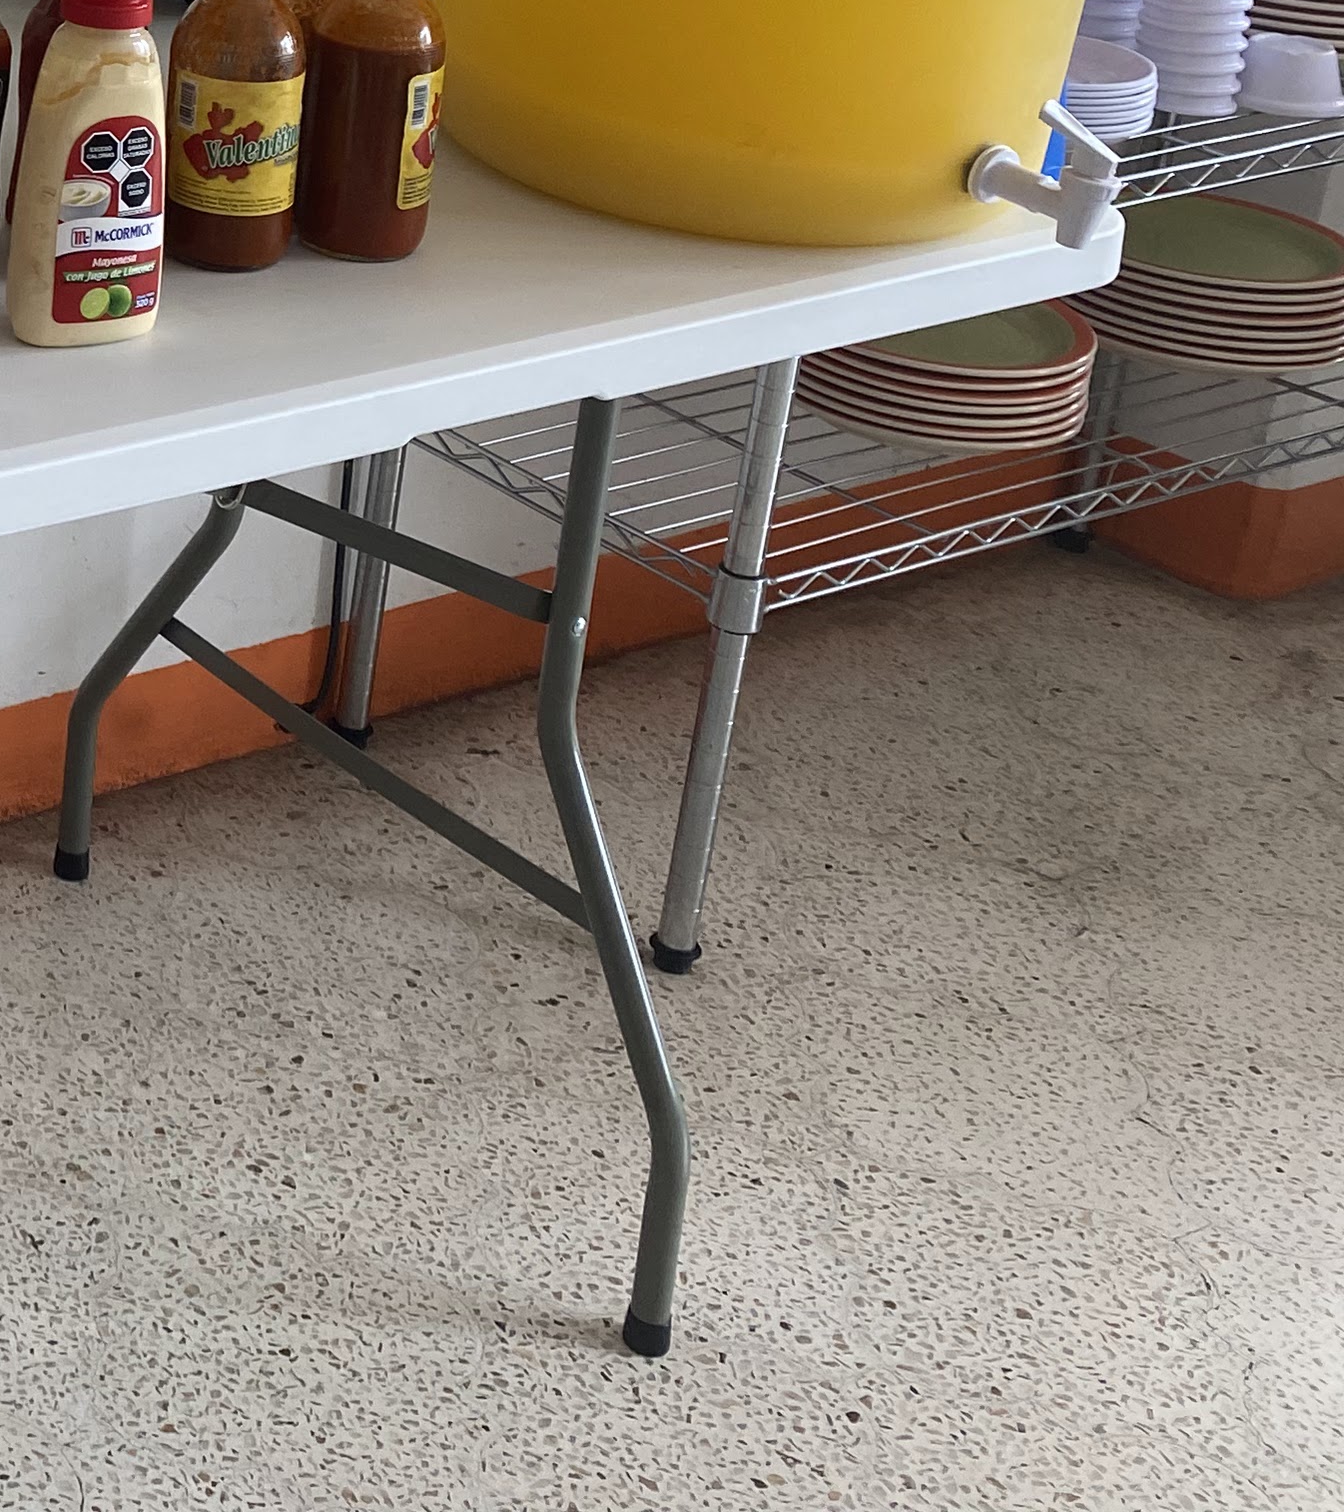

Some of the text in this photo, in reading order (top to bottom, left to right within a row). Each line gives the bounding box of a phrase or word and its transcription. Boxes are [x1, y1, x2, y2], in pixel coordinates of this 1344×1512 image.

[203, 123, 300, 168] Valentin
[95, 224, 152, 243] McCORMICK
[92, 254, 138, 267] Mayonesa
[65, 272, 84, 282] con
[84, 271, 109, 283] Jugo
[110, 269, 122, 278] de
